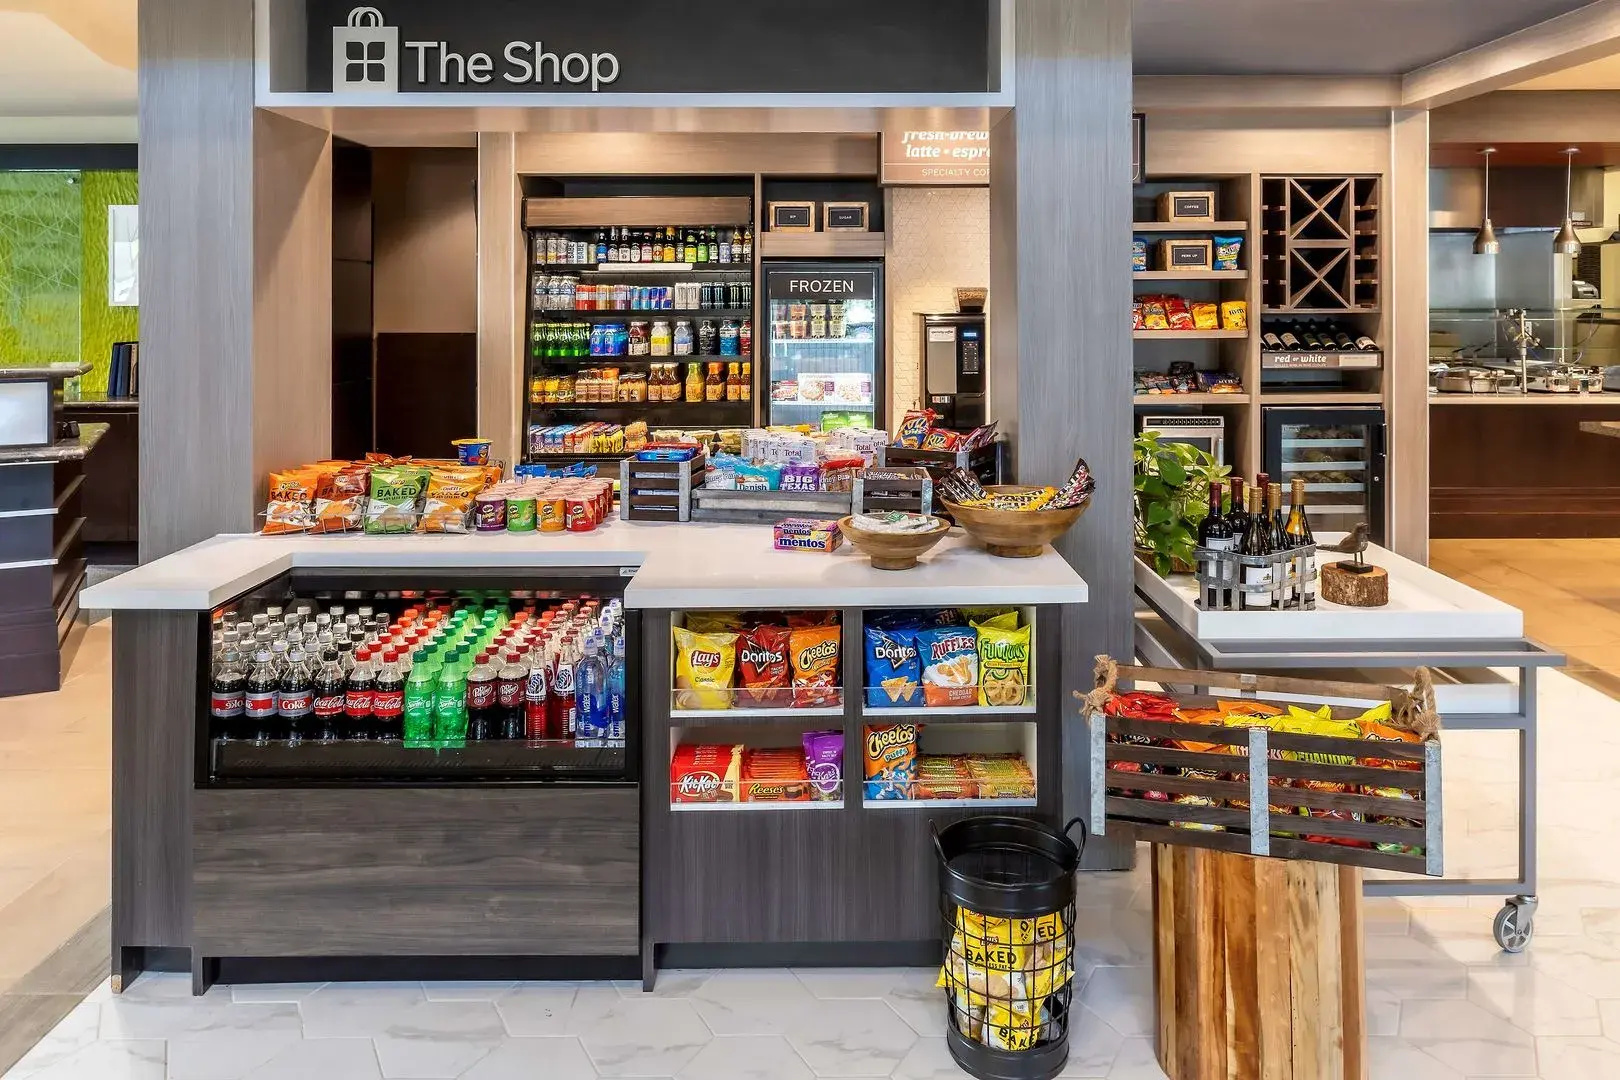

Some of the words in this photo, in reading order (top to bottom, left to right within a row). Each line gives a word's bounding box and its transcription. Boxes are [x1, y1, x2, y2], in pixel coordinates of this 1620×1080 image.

[405, 41, 493, 83] The
[502, 40, 620, 92] Shop
[906, 144, 940, 157] latte
[922, 168, 970, 176] SPECIALTY
[790, 280, 854, 293] FROZEN
[1274, 354, 1291, 363] red
[1300, 354, 1327, 363] white
[873, 441, 885, 449] otal
[784, 475, 813, 483] BIG
[377, 488, 417, 498] BAKED
[780, 483, 816, 491] TEXAS
[271, 491, 307, 500] BAKED
[779, 538, 826, 548] mentos
[931, 637, 975, 660] RUFFLES
[980, 638, 1025, 662] FUNYUNS
[741, 649, 783, 663] Doritos
[799, 641, 838, 670] Cheetos
[282, 699, 306, 710] Coke
[314, 694, 345, 709] Coca-Cola
[868, 725, 915, 757] Cheetos
[966, 949, 1017, 965] BAKED
[999, 1026, 1038, 1048] BAKE
